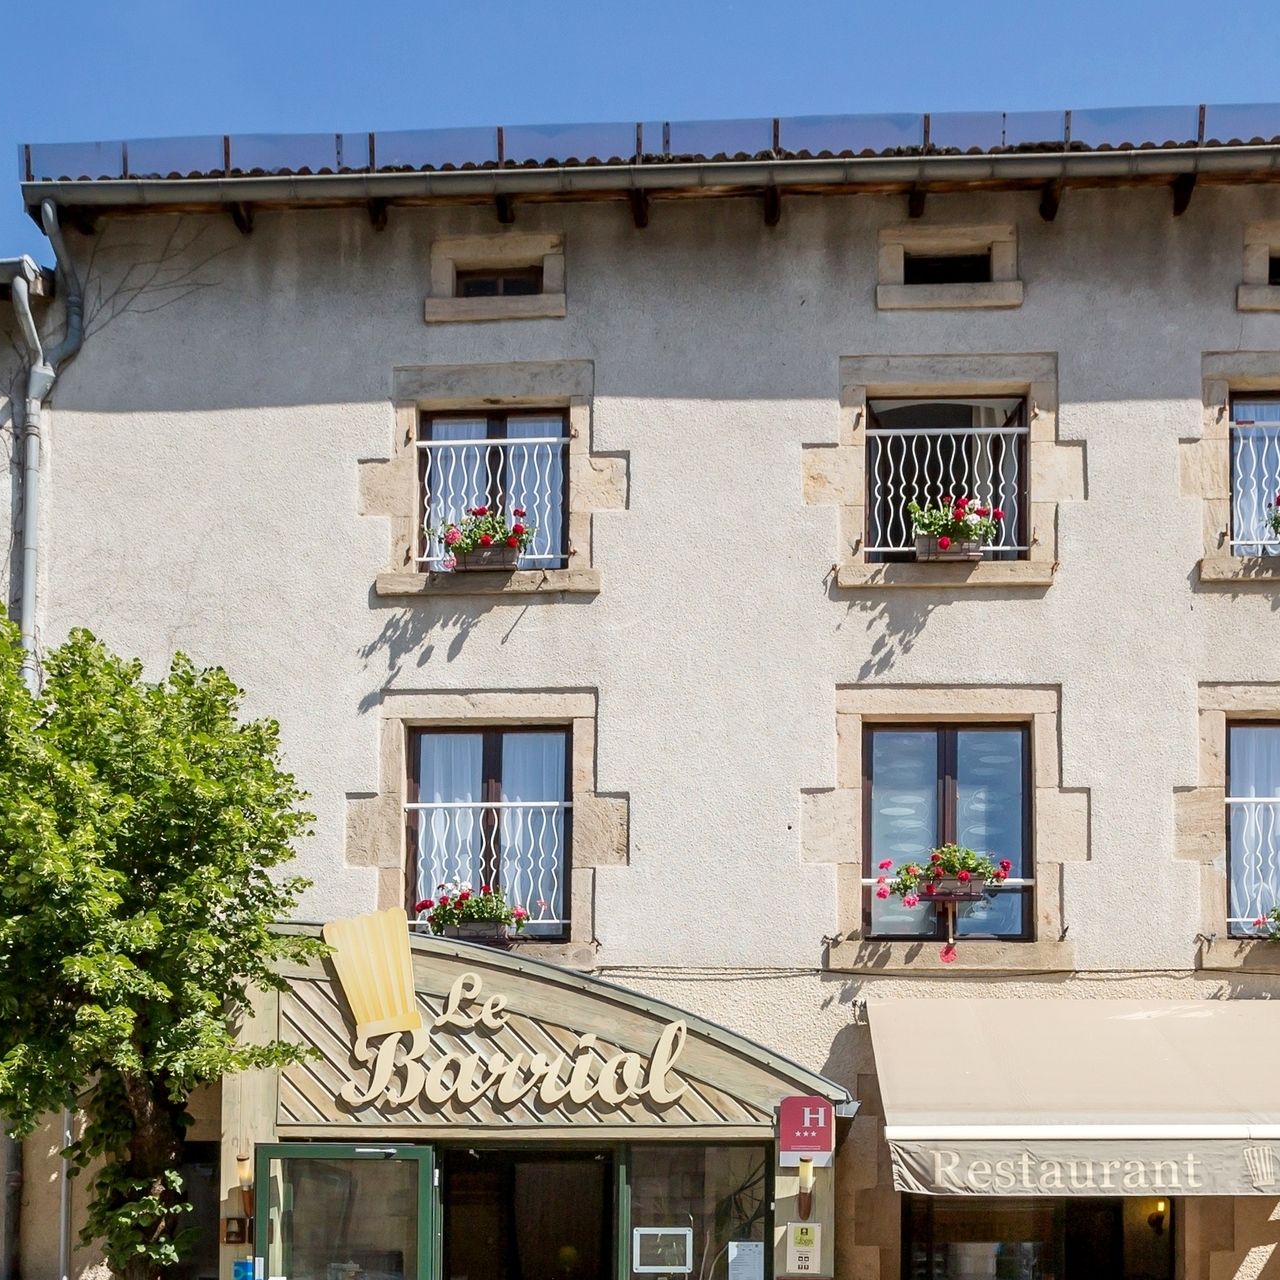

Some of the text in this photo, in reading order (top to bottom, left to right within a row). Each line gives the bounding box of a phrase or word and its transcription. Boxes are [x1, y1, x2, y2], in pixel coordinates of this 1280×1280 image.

[434, 972, 510, 1028] Le
[341, 1020, 690, 1104] Barriol
[802, 1107, 827, 1128] H
[929, 1150, 1202, 1188] Restaurant
